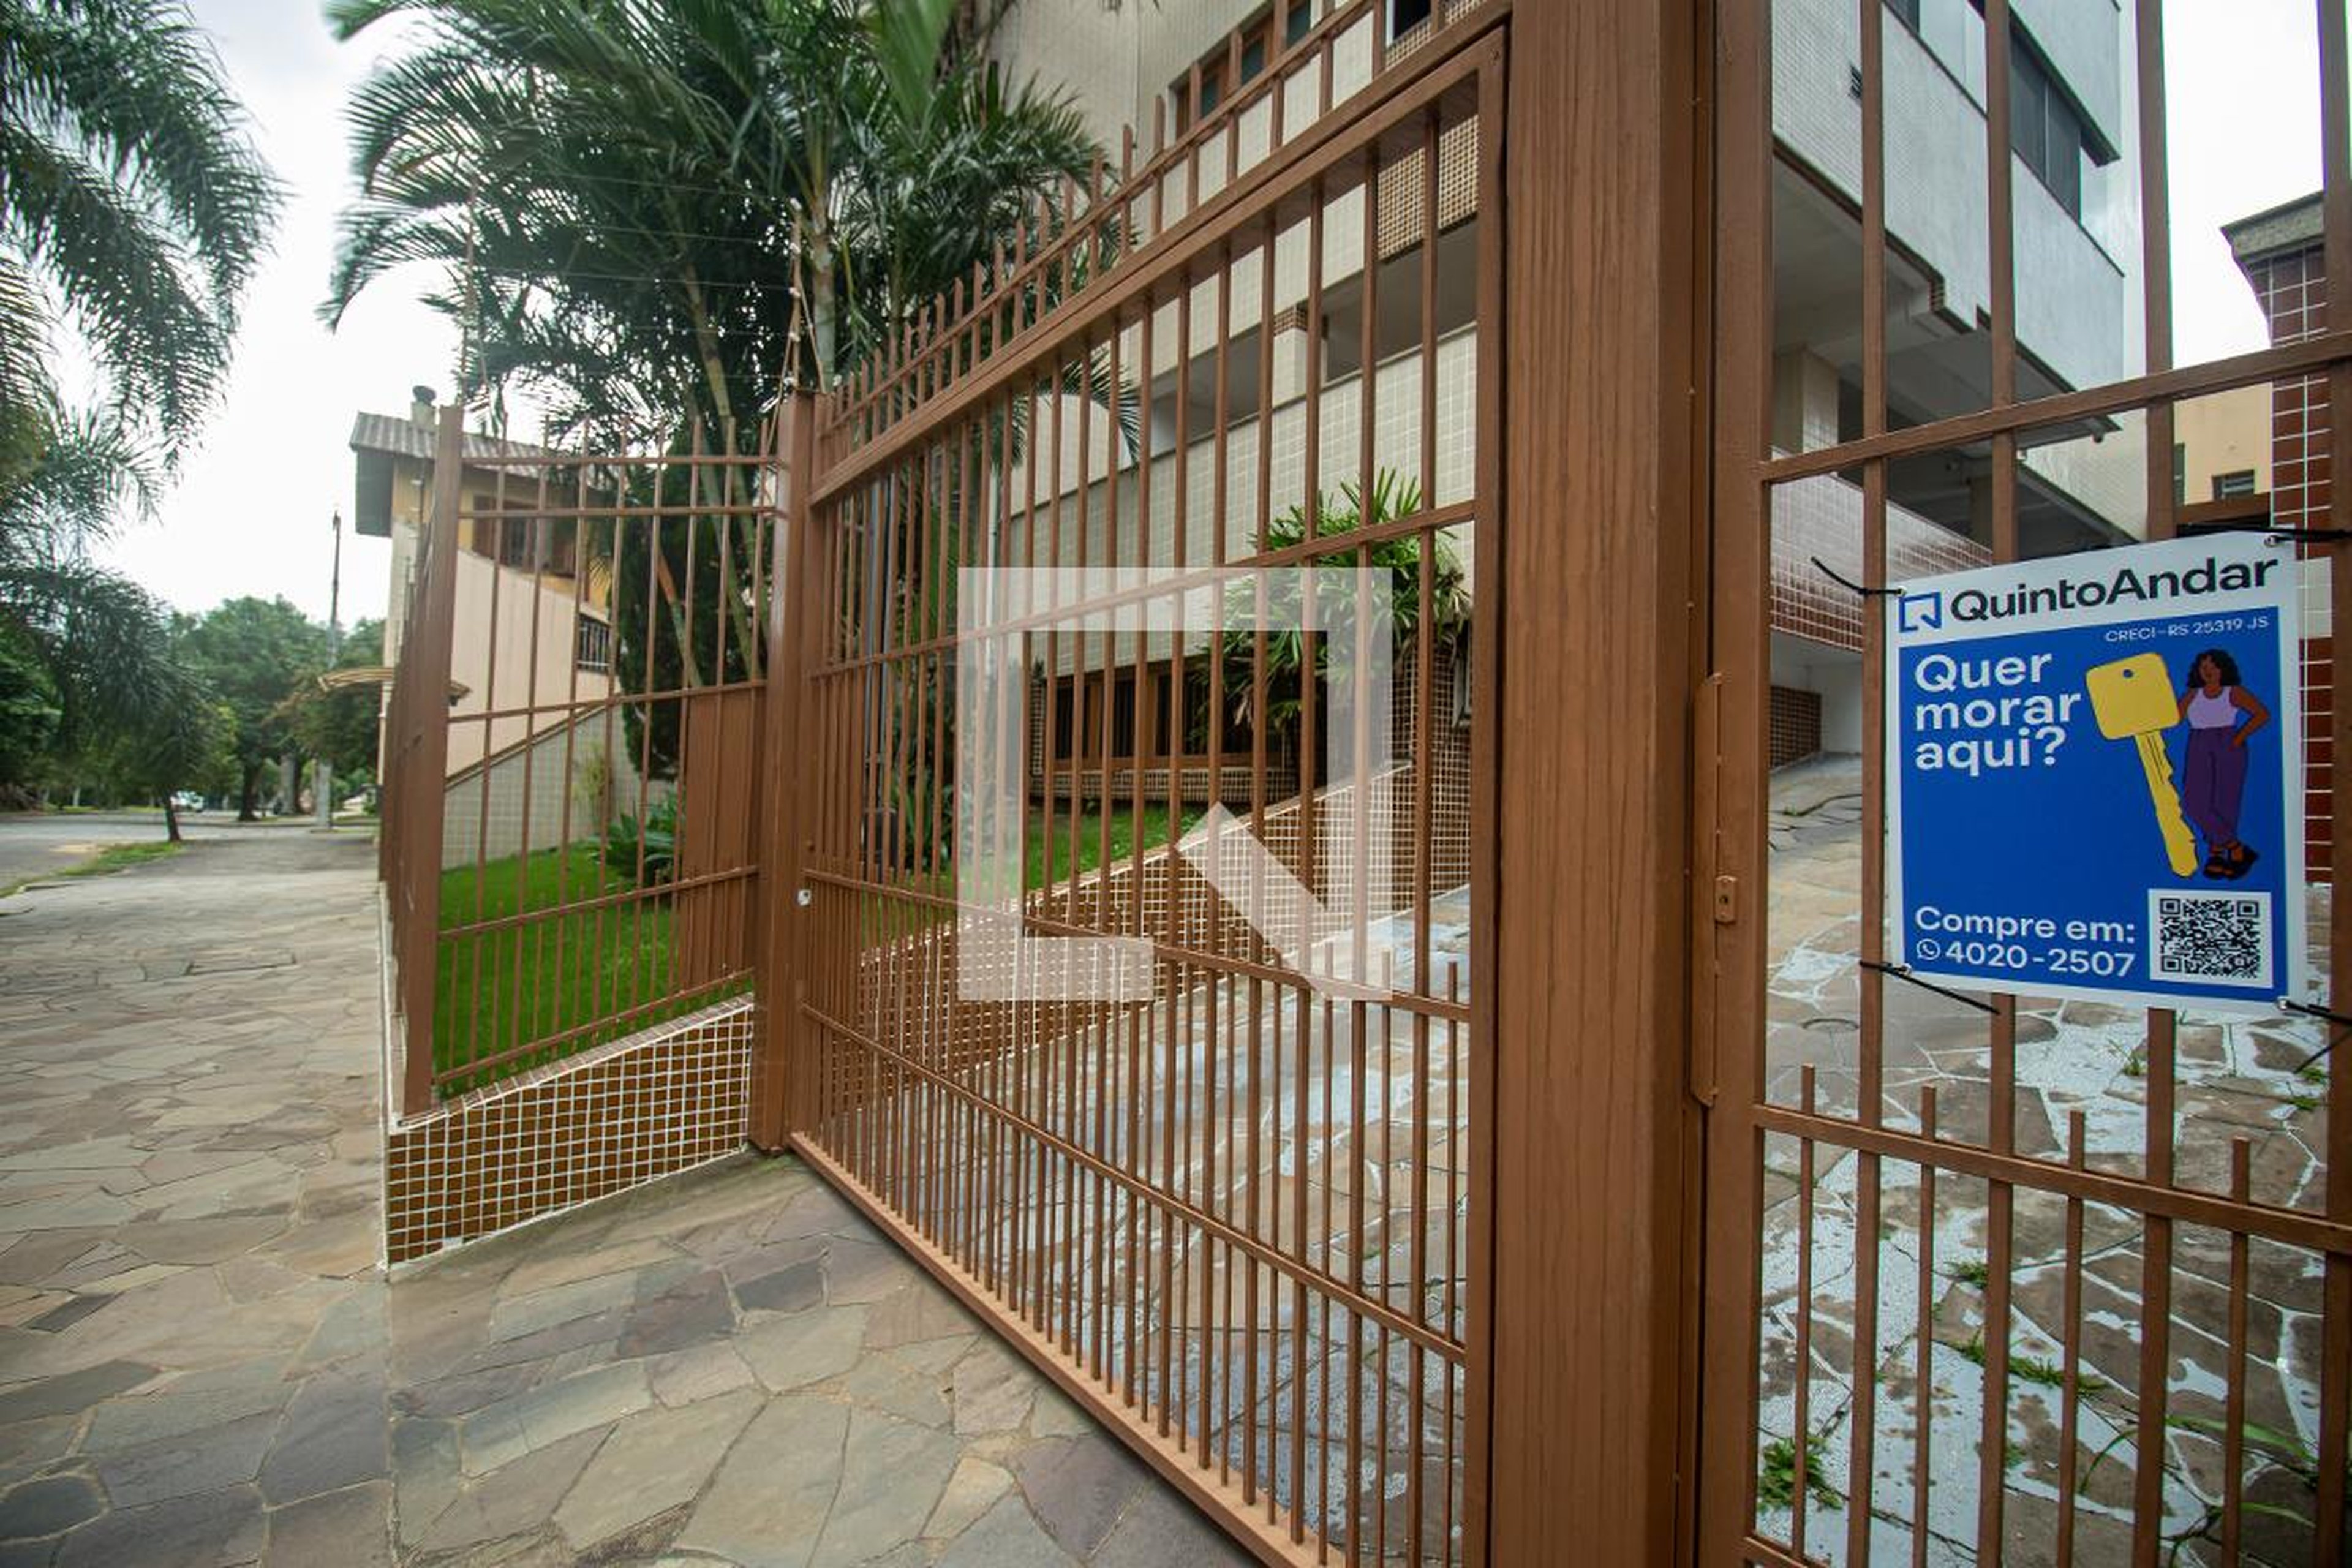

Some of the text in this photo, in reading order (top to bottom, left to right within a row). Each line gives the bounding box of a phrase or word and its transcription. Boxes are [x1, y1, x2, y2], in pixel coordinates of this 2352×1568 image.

[1951, 556, 2278, 622] QuintoAndar
[2194, 620, 2243, 635] 25319
[2247, 616, 2270, 630] JS
[1914, 652, 2052, 693] Quer
[1915, 692, 2081, 731] morar
[1915, 726, 2067, 777] aqui?
[1915, 907, 2136, 943] Compre em:
[1945, 943, 2136, 977] 4020-2507
